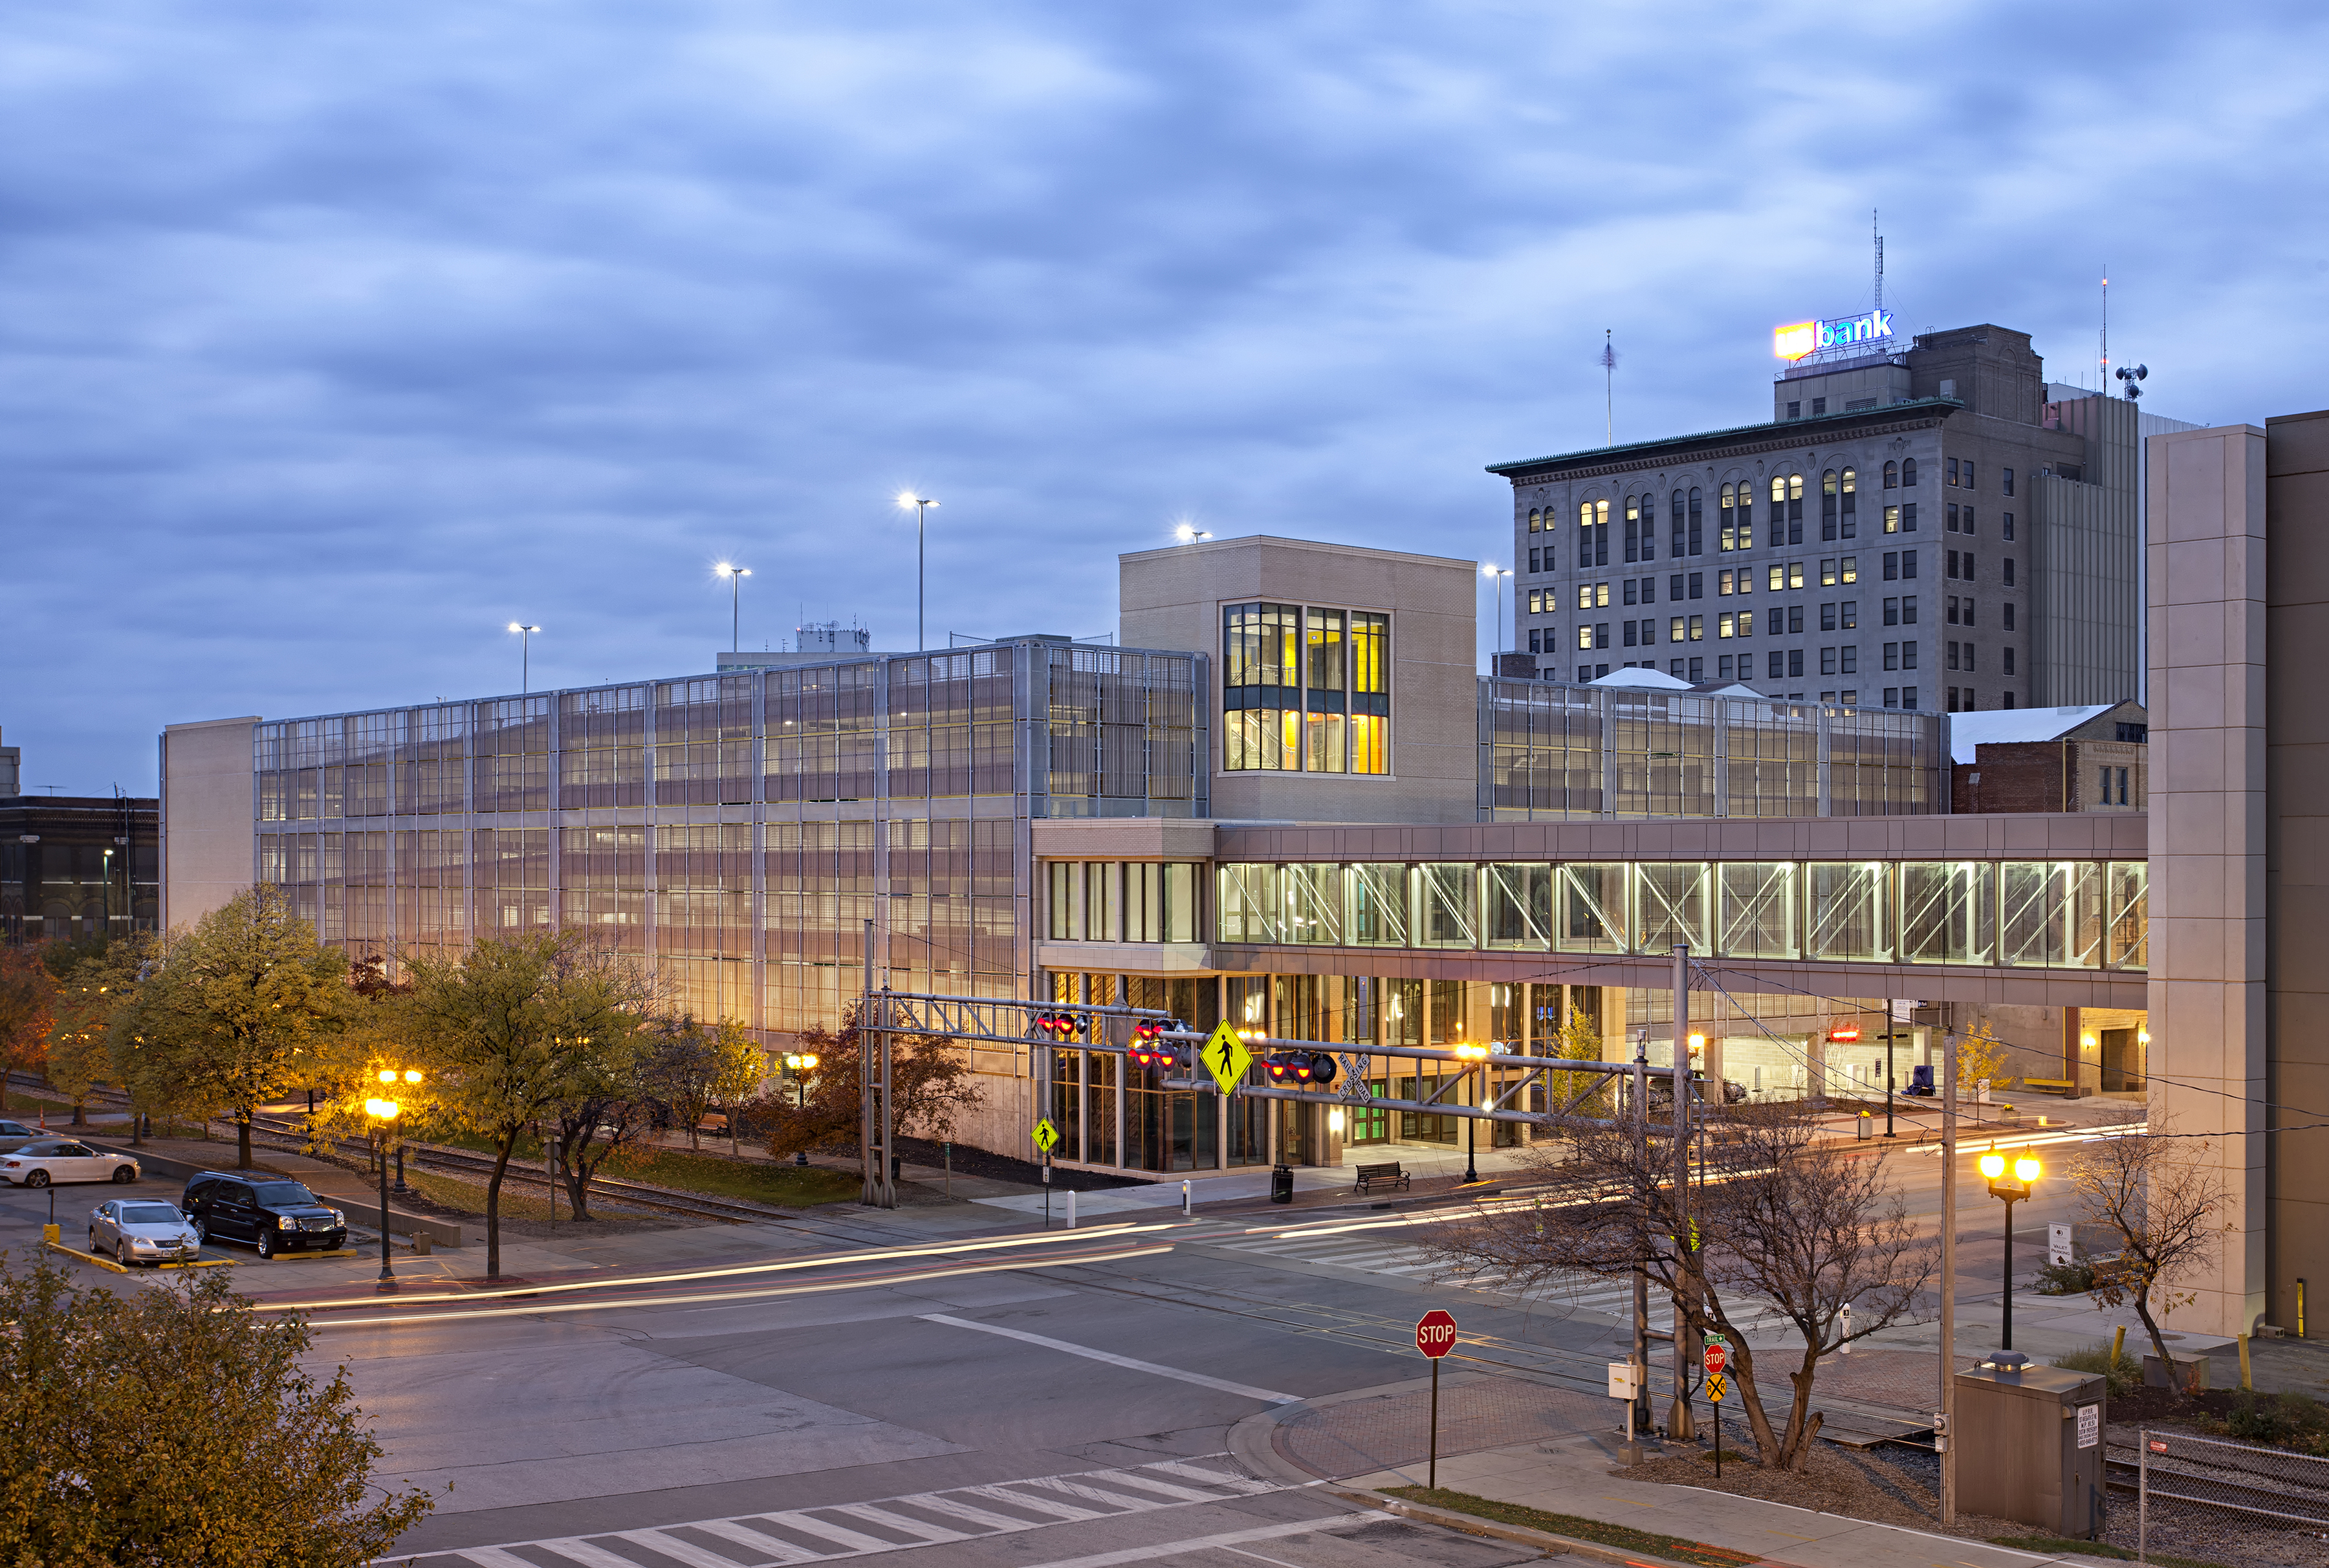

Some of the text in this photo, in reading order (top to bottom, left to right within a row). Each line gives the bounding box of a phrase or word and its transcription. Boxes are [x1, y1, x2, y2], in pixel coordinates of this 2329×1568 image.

[1815, 309, 1894, 348] bank
[1340, 1058, 1367, 1097] CROSSING
[1419, 1324, 1454, 1344] STOP
[1705, 1353, 1724, 1365] STOP
